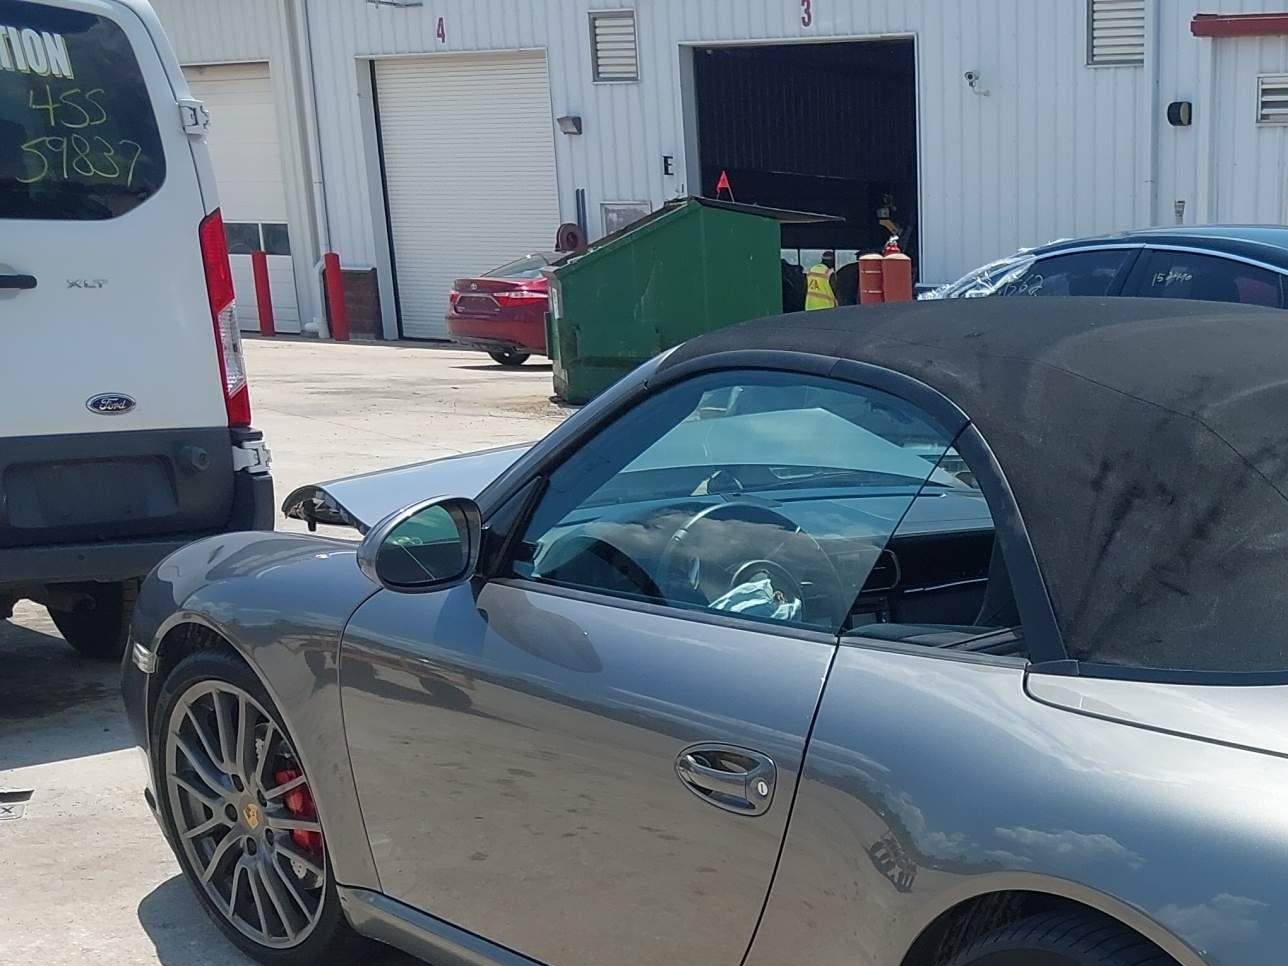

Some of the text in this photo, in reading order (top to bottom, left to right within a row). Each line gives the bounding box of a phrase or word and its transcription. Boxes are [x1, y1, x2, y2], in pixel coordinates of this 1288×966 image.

[800, 0, 812, 28] 3
[436, 16, 446, 44] 4
[15, 133, 142, 187] 59837
[663, 155, 674, 176] E
[66, 279, 108, 289] XLT
[99, 398, 127, 411] Ford
